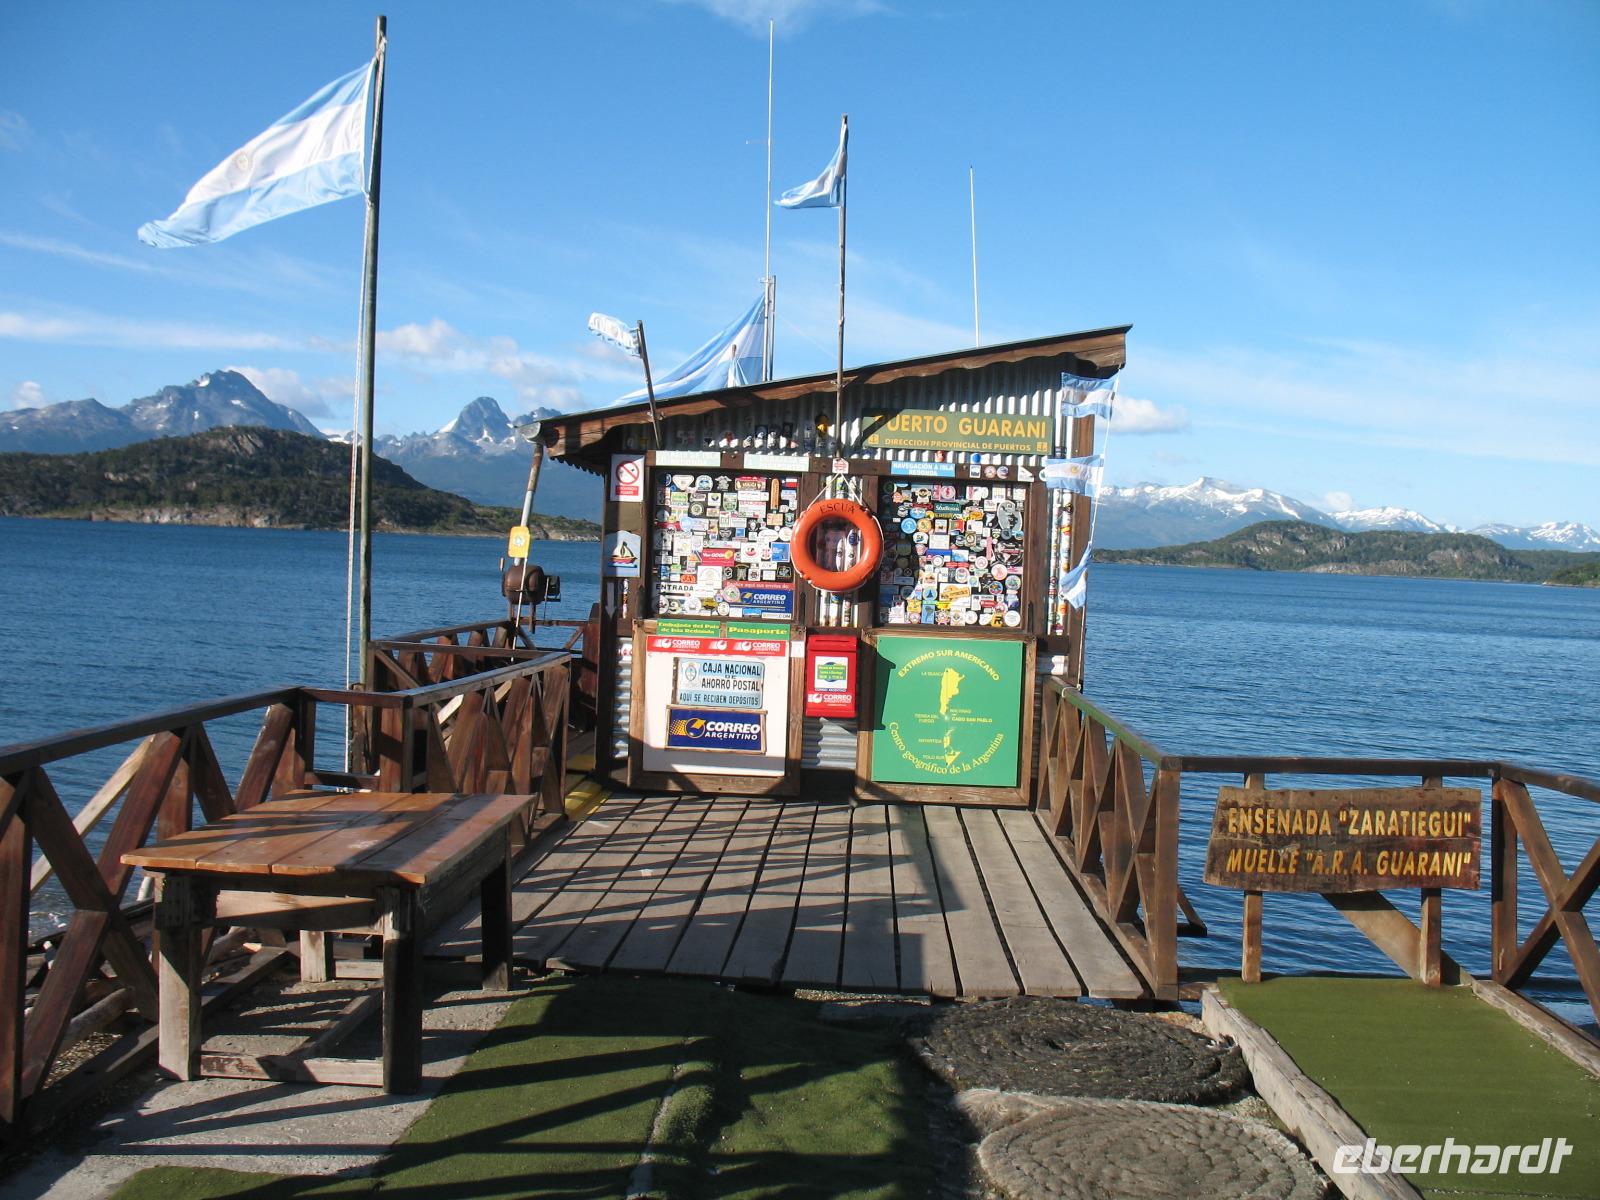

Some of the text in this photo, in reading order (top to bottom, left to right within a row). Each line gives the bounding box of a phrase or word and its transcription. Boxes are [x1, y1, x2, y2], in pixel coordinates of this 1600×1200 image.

[872, 413, 1046, 439] UERTO GUARANI
[931, 441, 980, 450] PROVINCIAL
[994, 443, 1032, 452] PUERTOS
[656, 584, 694, 592] ENTRADA
[729, 627, 787, 636] Pasaporte
[703, 663, 761, 676] CAJA NACIONAL
[898, 649, 1000, 681] EXTREMO SUR AMERICANO
[702, 679, 760, 692] AHORRO POSTAL
[694, 693, 702, 702] SE
[704, 694, 727, 704] RECIBEN
[706, 720, 761, 733] CORREO
[704, 732, 758, 741] ARGENTINO
[890, 721, 1004, 775] Centro geográfico de la Argentina
[1227, 808, 1471, 839] ENSENADA "ZARATIEGUI"
[1226, 849, 1300, 874] MUELLE
[1376, 851, 1471, 878] GUARANI"
